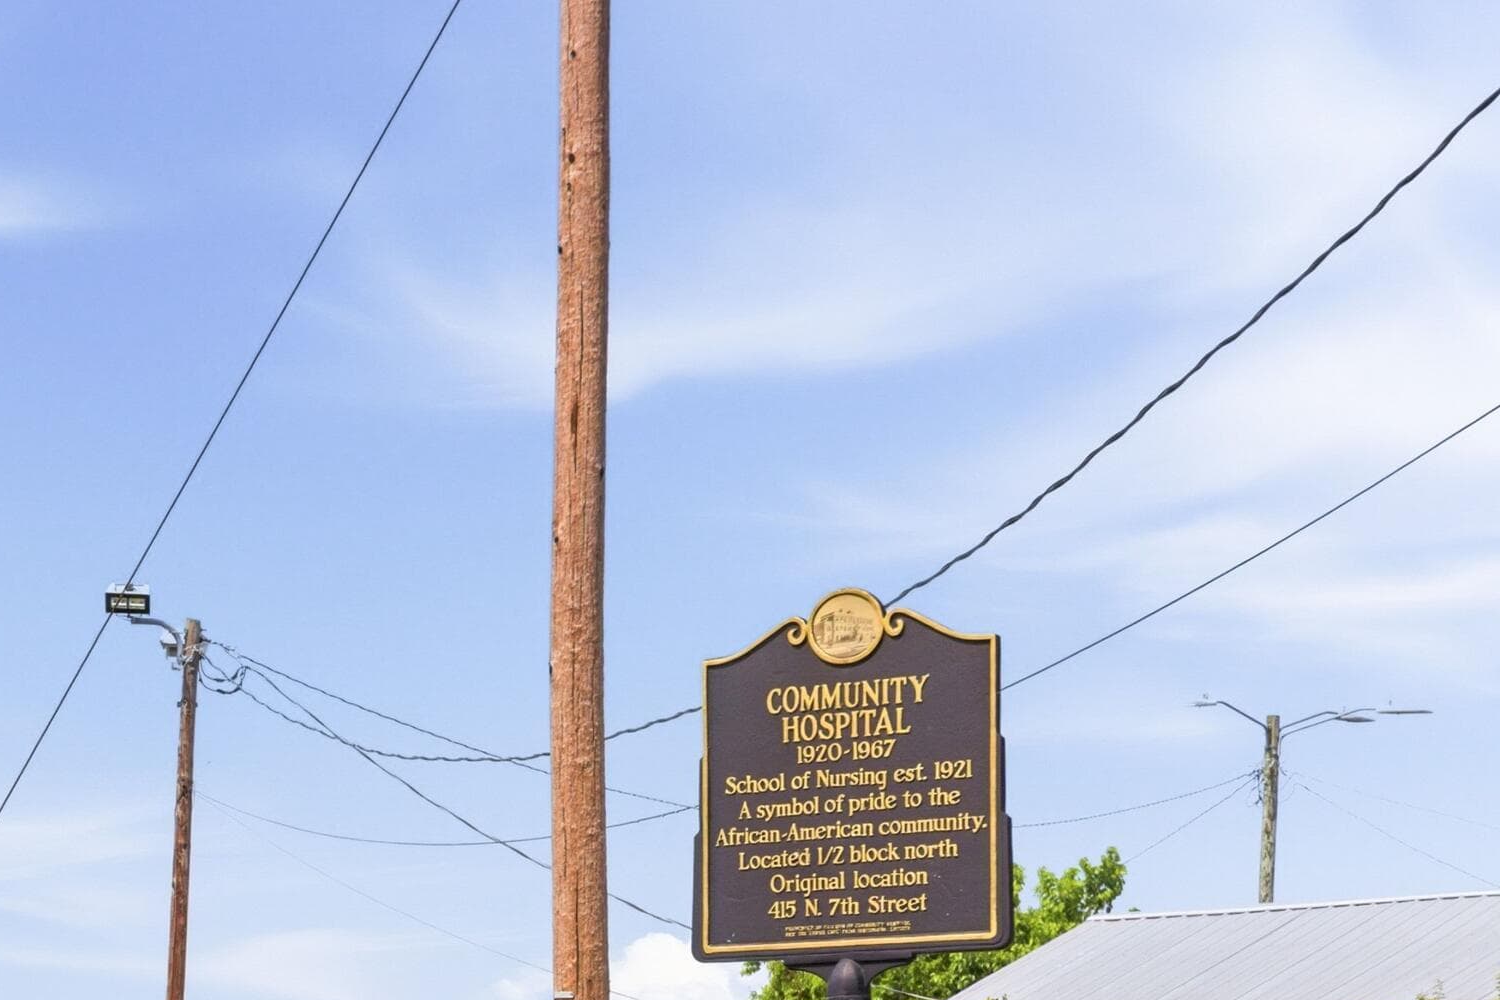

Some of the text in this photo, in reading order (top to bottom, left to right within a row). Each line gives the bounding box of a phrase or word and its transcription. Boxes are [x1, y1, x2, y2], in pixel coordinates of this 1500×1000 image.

[766, 674, 929, 715] COMMUNITY
[782, 707, 911, 744] HOSPITAL
[796, 739, 897, 765] 1920-1967
[724, 759, 973, 795] School of Nursing est. 1921
[739, 786, 961, 821] A symbol of pride to the
[716, 811, 989, 847] African-American community.
[739, 838, 959, 871] Located 1/2 block north
[770, 867, 929, 897] Original location
[767, 892, 928, 920] 415 N. 7th Street
